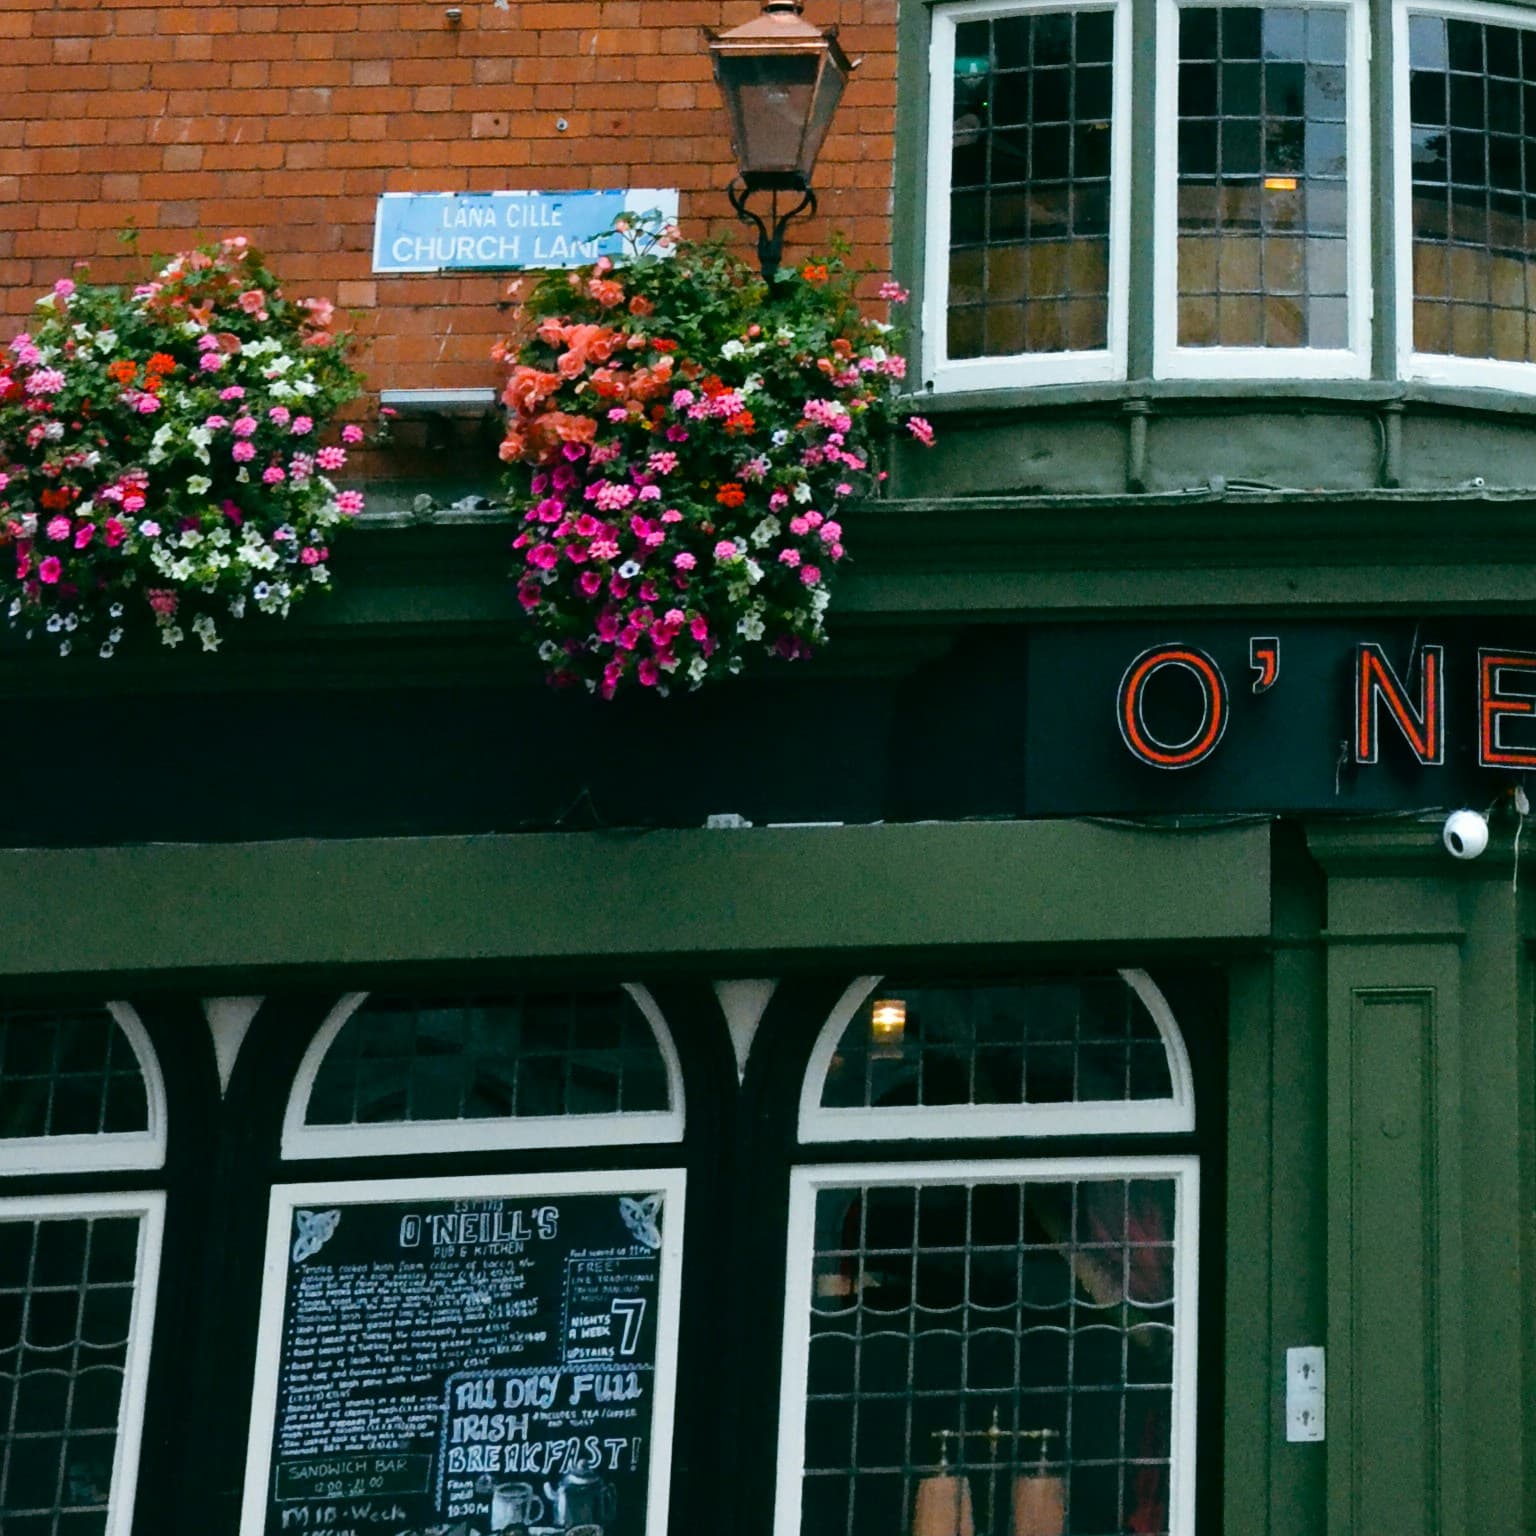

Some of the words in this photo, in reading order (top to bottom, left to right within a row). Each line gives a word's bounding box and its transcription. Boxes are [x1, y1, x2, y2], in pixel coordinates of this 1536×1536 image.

[507, 203, 563, 228] CILLE
[392, 235, 519, 263] CHURCH
[401, 1206, 558, 1247] O'NEILL'S
[474, 1241, 525, 1256] KITCHEN
[571, 1314, 612, 1327] NIGHTS
[581, 1326, 611, 1339] WEEK
[611, 1297, 647, 1355] 7
[567, 1346, 615, 1359] UPSTAIRS
[503, 1373, 561, 1410] DAY
[450, 1412, 529, 1443] IRISH
[288, 1461, 368, 1480] SANDWICH
[375, 1459, 408, 1473] BAR
